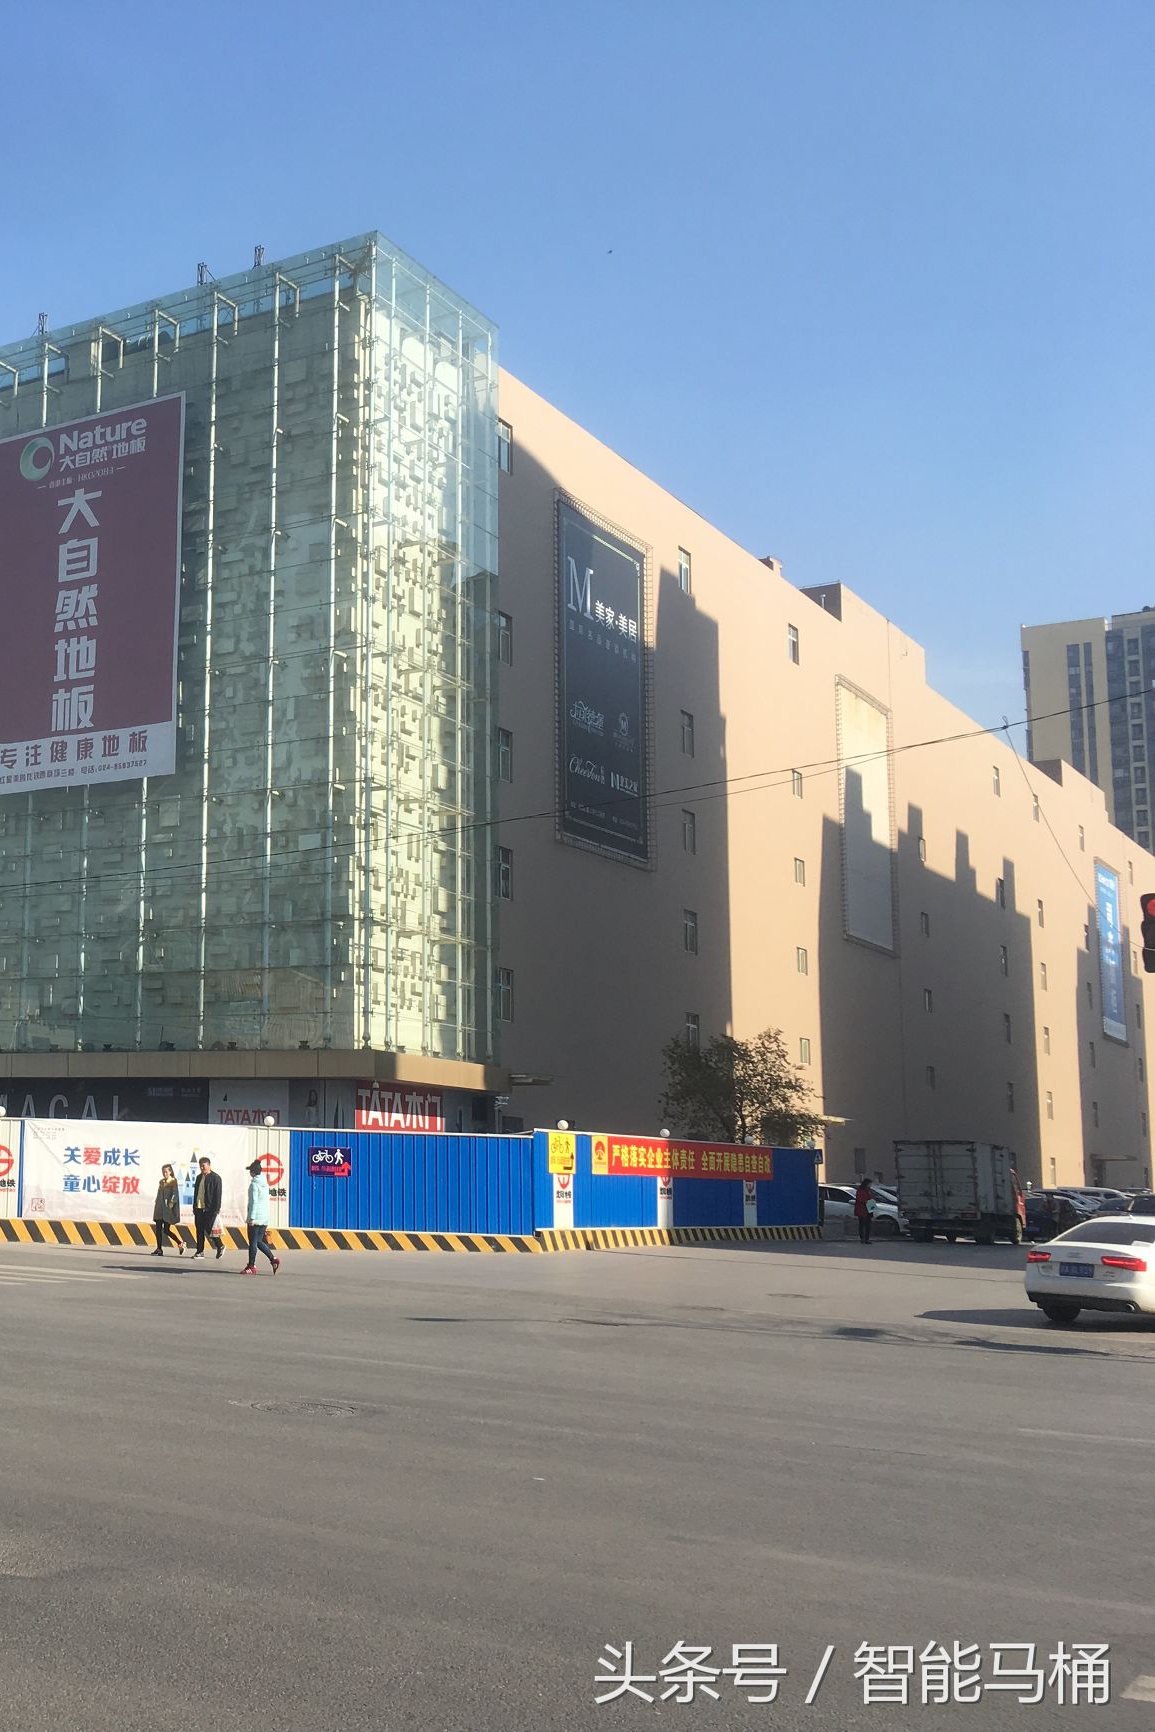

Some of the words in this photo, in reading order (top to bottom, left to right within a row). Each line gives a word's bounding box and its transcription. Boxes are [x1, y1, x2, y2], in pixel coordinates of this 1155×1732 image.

[59, 418, 147, 455] Nature
[567, 555, 594, 620] M
[50, 488, 102, 732] 大自然地板
[0, 730, 147, 769] 专注健康地板
[357, 1088, 444, 1132] TATA木门
[63, 1146, 140, 1167] 关爱成长
[611, 1144, 696, 1171] 严格落实企业主体责任
[701, 1150, 772, 1174] 全面开展隐患自查自改
[63, 1174, 140, 1195] 童心绽放
[268, 1187, 286, 1197] 地铁
